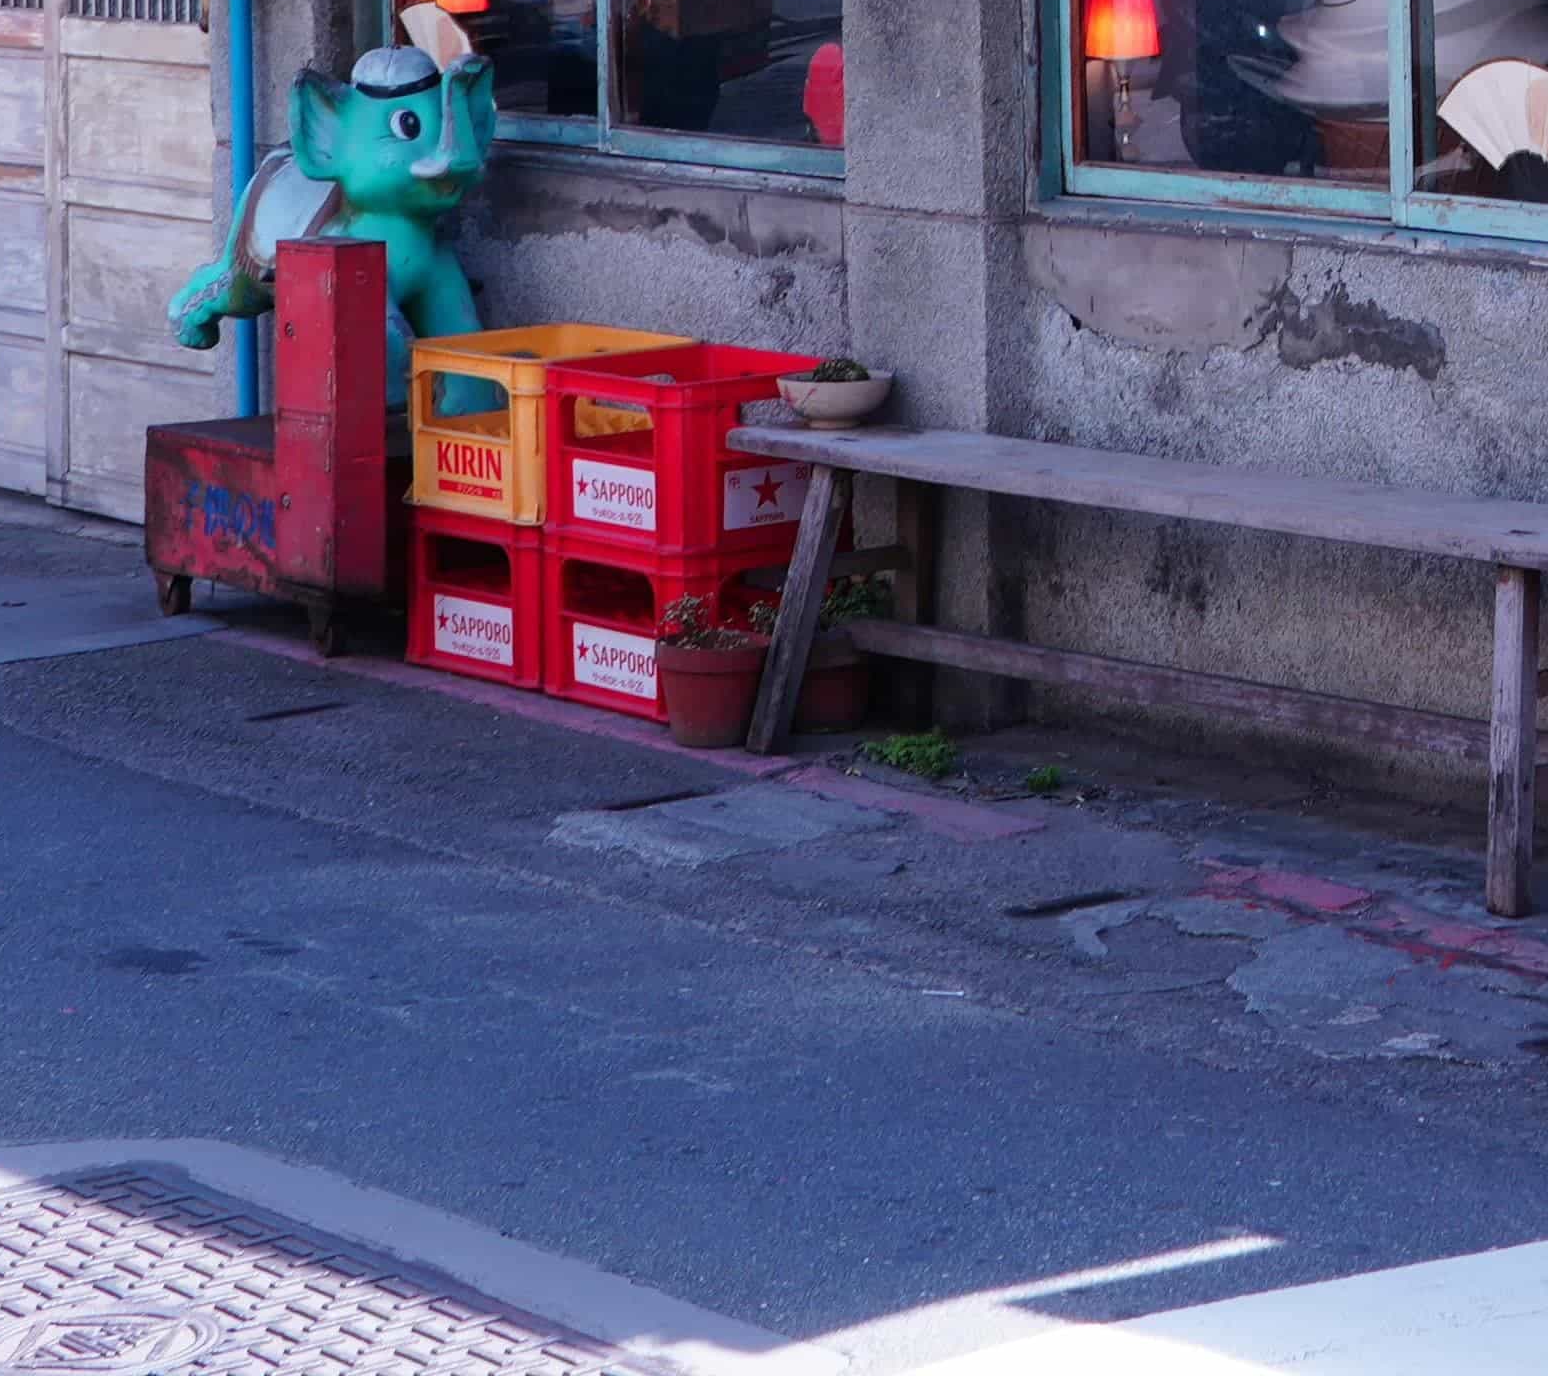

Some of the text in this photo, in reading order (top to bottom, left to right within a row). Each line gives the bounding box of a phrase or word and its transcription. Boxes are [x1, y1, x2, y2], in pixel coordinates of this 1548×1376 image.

[436, 440, 502, 481] KIRIN
[591, 477, 654, 510] SAPPORO
[451, 612, 511, 645] SAPPORO
[591, 643, 656, 678] SAPPORO
